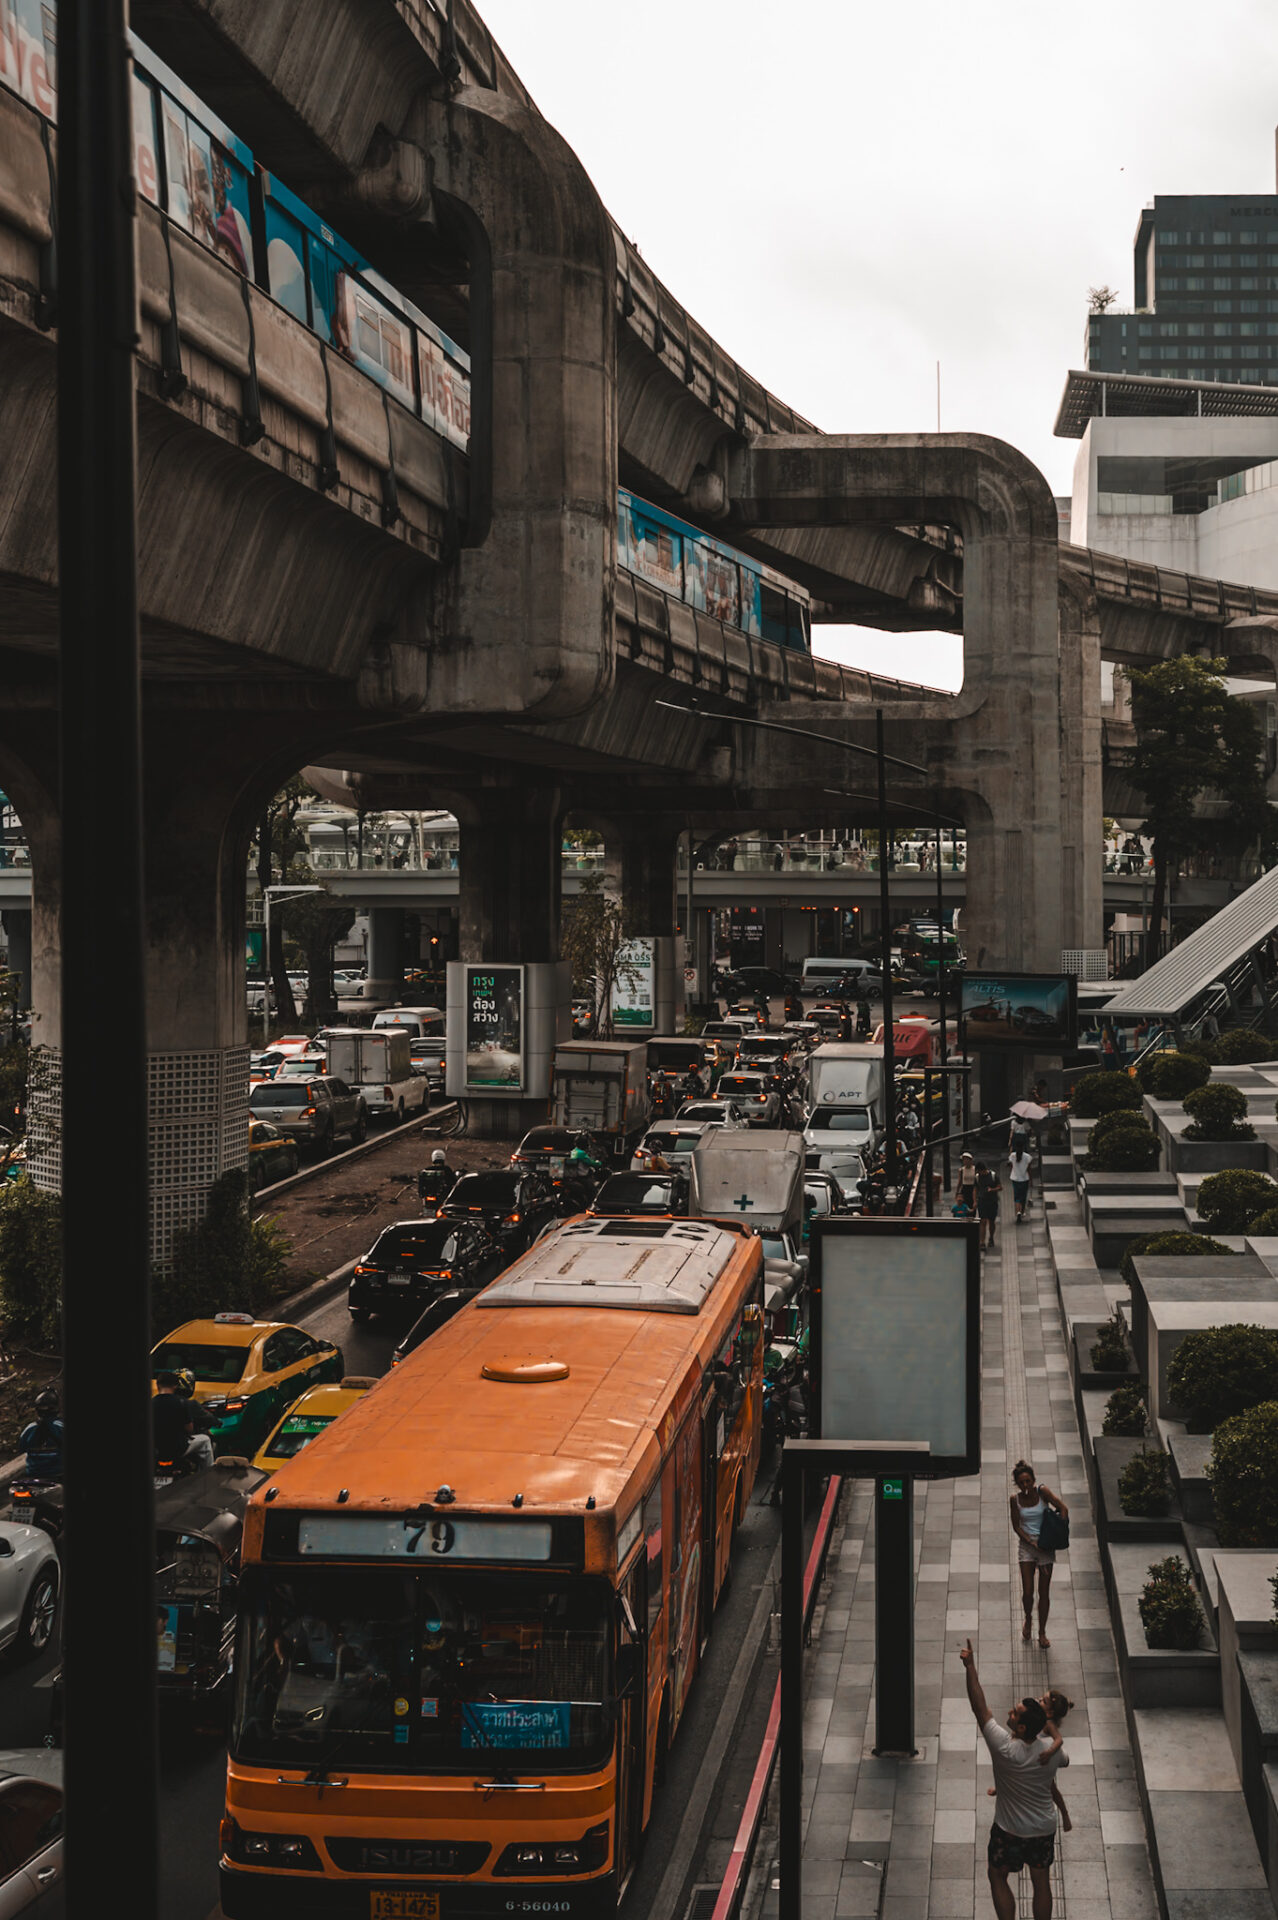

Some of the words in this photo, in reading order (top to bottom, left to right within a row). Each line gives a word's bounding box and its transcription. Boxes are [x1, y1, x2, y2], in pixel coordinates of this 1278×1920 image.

[472, 976, 495, 990] กรุง
[969, 984, 1007, 994] ALTIS
[473, 997, 496, 1010] ต้อง
[472, 1010, 499, 1022] สว่าง
[404, 1519, 455, 1554] 79
[359, 1847, 458, 1868] ISUZU
[376, 1898, 437, 1915] 13-1475
